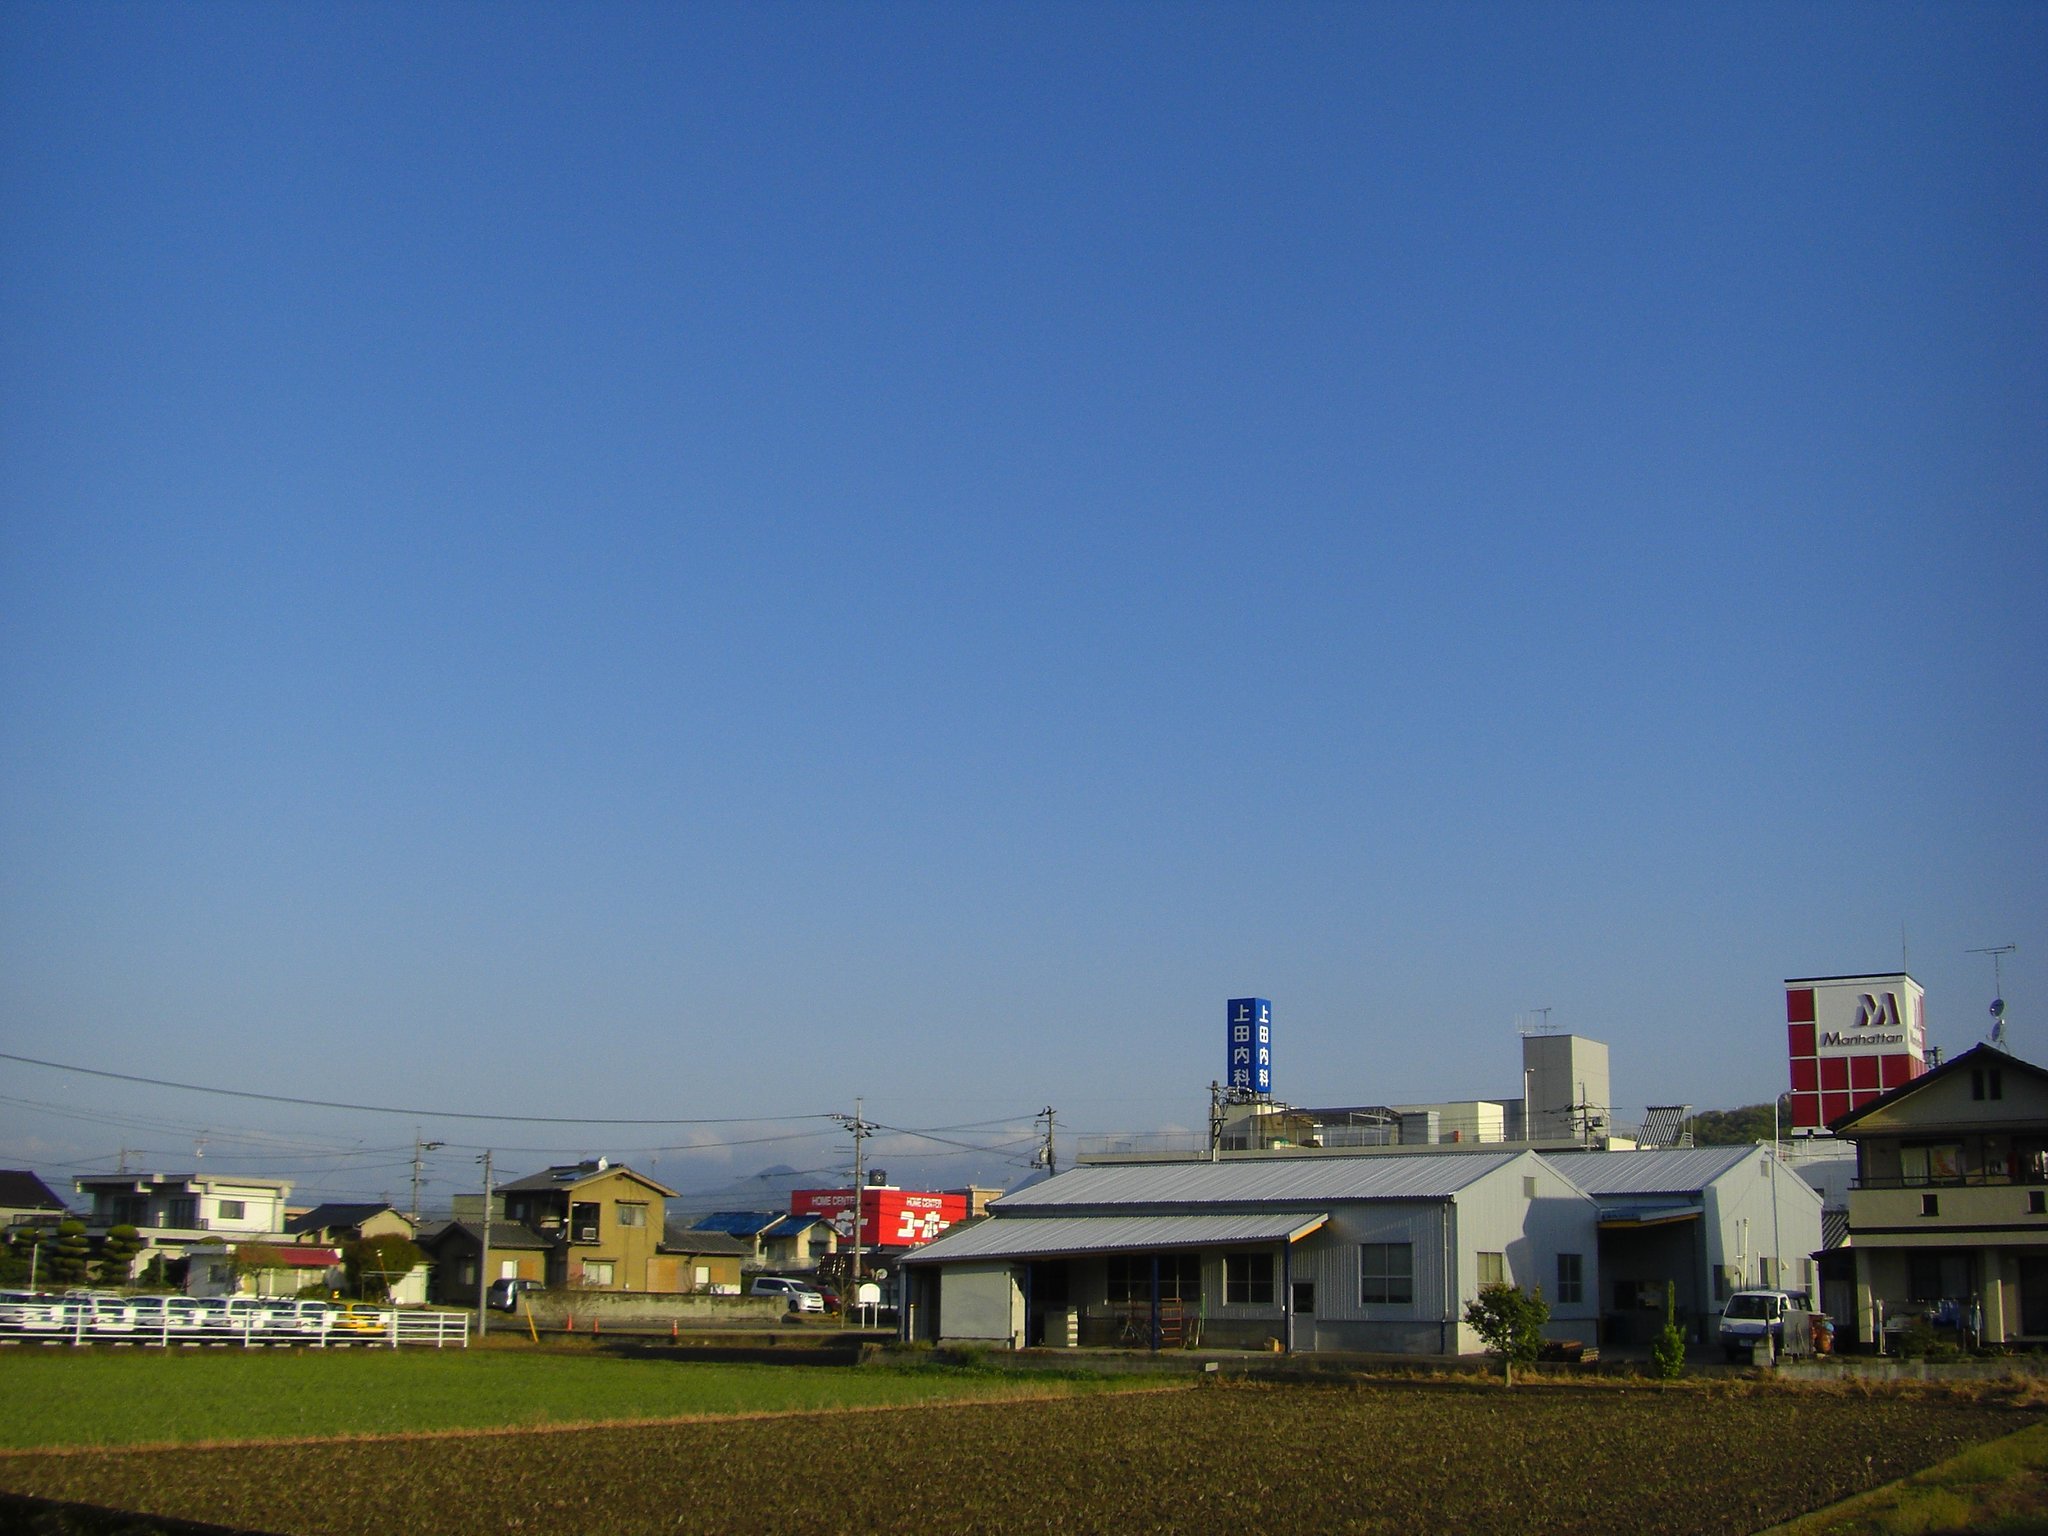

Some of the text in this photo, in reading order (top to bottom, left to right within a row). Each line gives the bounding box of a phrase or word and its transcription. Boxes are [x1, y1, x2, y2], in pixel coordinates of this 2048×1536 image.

[1233, 1004, 1250, 1086] 上田内科
[1259, 1004, 1269, 1087] 上田内科
[1823, 1031, 1904, 1047] Manhattan
[811, 1195, 859, 1206] HOME CENTE
[906, 1197, 943, 1209] HOME CENTER
[897, 1210, 951, 1238] ユーホー
